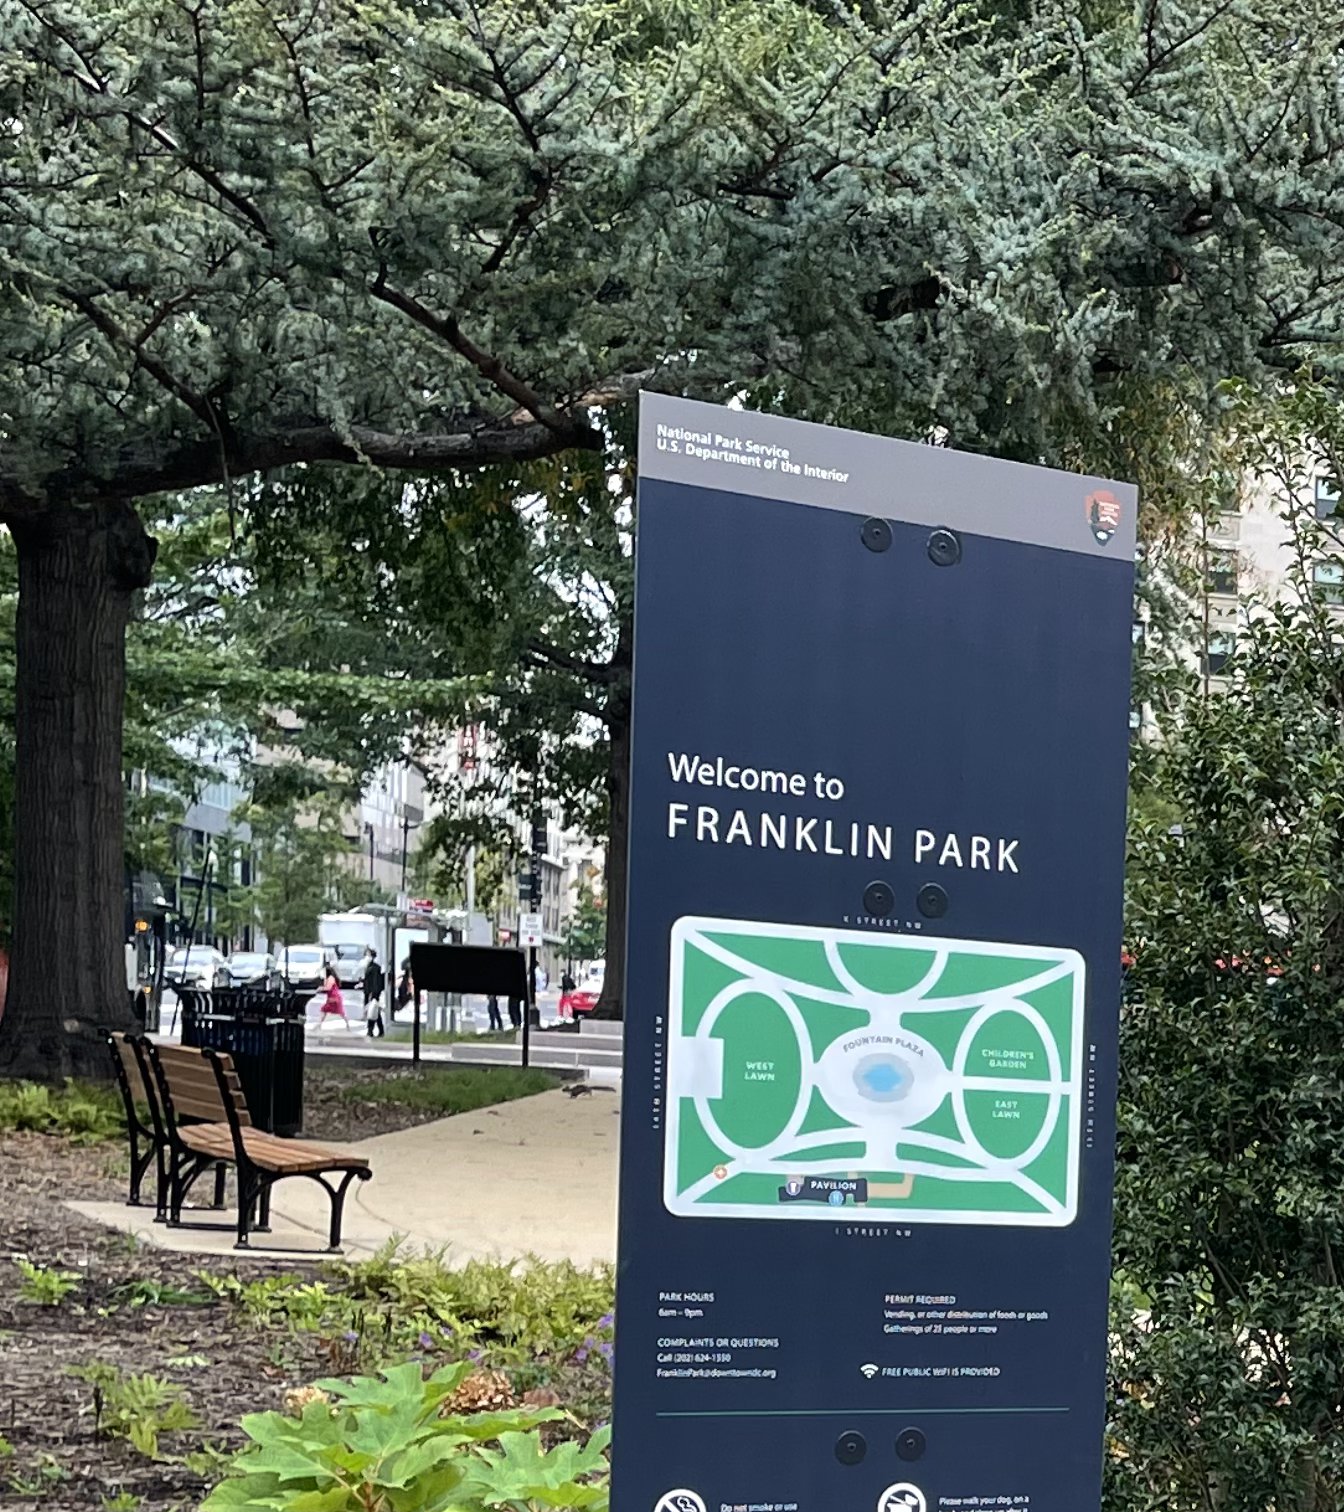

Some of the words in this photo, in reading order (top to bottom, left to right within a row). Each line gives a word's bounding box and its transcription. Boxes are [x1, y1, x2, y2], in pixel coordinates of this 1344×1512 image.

[657, 424, 711, 444] National
[715, 435, 742, 450] Park
[746, 441, 789, 459] Service
[657, 438, 681, 453] U.S.
[686, 443, 761, 468] Department
[764, 457, 778, 469] of
[781, 459, 801, 475] the
[804, 463, 849, 483] Interior
[667, 752, 807, 796] Welcome
[814, 772, 844, 800] to
[667, 803, 893, 860] FRANKLIN
[914, 830, 1019, 873] PARK
[843, 915, 849, 923] K
[857, 916, 898, 927] STREET
[906, 921, 921, 929] NW
[656, 1016, 663, 1033] NW
[843, 1035, 893, 1053] FOUNTAIN
[895, 1037, 924, 1057] PLAZA
[982, 1049, 1034, 1060] CHILDREN'S
[654, 1043, 662, 1089] STREET
[745, 1061, 775, 1071] WEST
[989, 1060, 1027, 1069] GARDEN
[744, 1072, 775, 1081] LAWN
[995, 1100, 1018, 1109] EAST
[992, 1110, 1020, 1119] LAWN
[810, 1181, 857, 1190] PAVILION
[846, 1227, 888, 1236] STREET
[659, 1292, 682, 1301] PARK
[684, 1292, 715, 1302] HOURS
[885, 1295, 914, 1304] PERMIT
[915, 1295, 956, 1304] REQUIRED
[658, 1308, 676, 1316] 6am
[926, 1310, 946, 1319] other
[947, 1310, 988, 1319] distribution
[989, 1310, 996, 1319] of
[1026, 1311, 1048, 1321] goods
[883, 1324, 923, 1334] Gatherings
[924, 1324, 932, 1333] of
[943, 1325, 969, 1334] people
[657, 1338, 714, 1348] COMPLAINTS
[716, 1338, 729, 1348] OR
[730, 1338, 780, 1348] QUESTIONS
[657, 1353, 673, 1363] Call
[674, 1353, 694, 1363] (202)
[882, 1367, 901, 1376] FREE
[903, 1367, 931, 1376] PUBLIC
[951, 1367, 959, 1376] IS
[960, 1367, 1000, 1376] PROVIDED
[939, 1497, 961, 1505] Please
[962, 1496, 979, 1505] walk
[980, 1498, 996, 1506] your
[721, 1504, 732, 1512] Do
[733, 1504, 747, 1512] not
[748, 1503, 773, 1512] smoke
[784, 1503, 798, 1511] use
